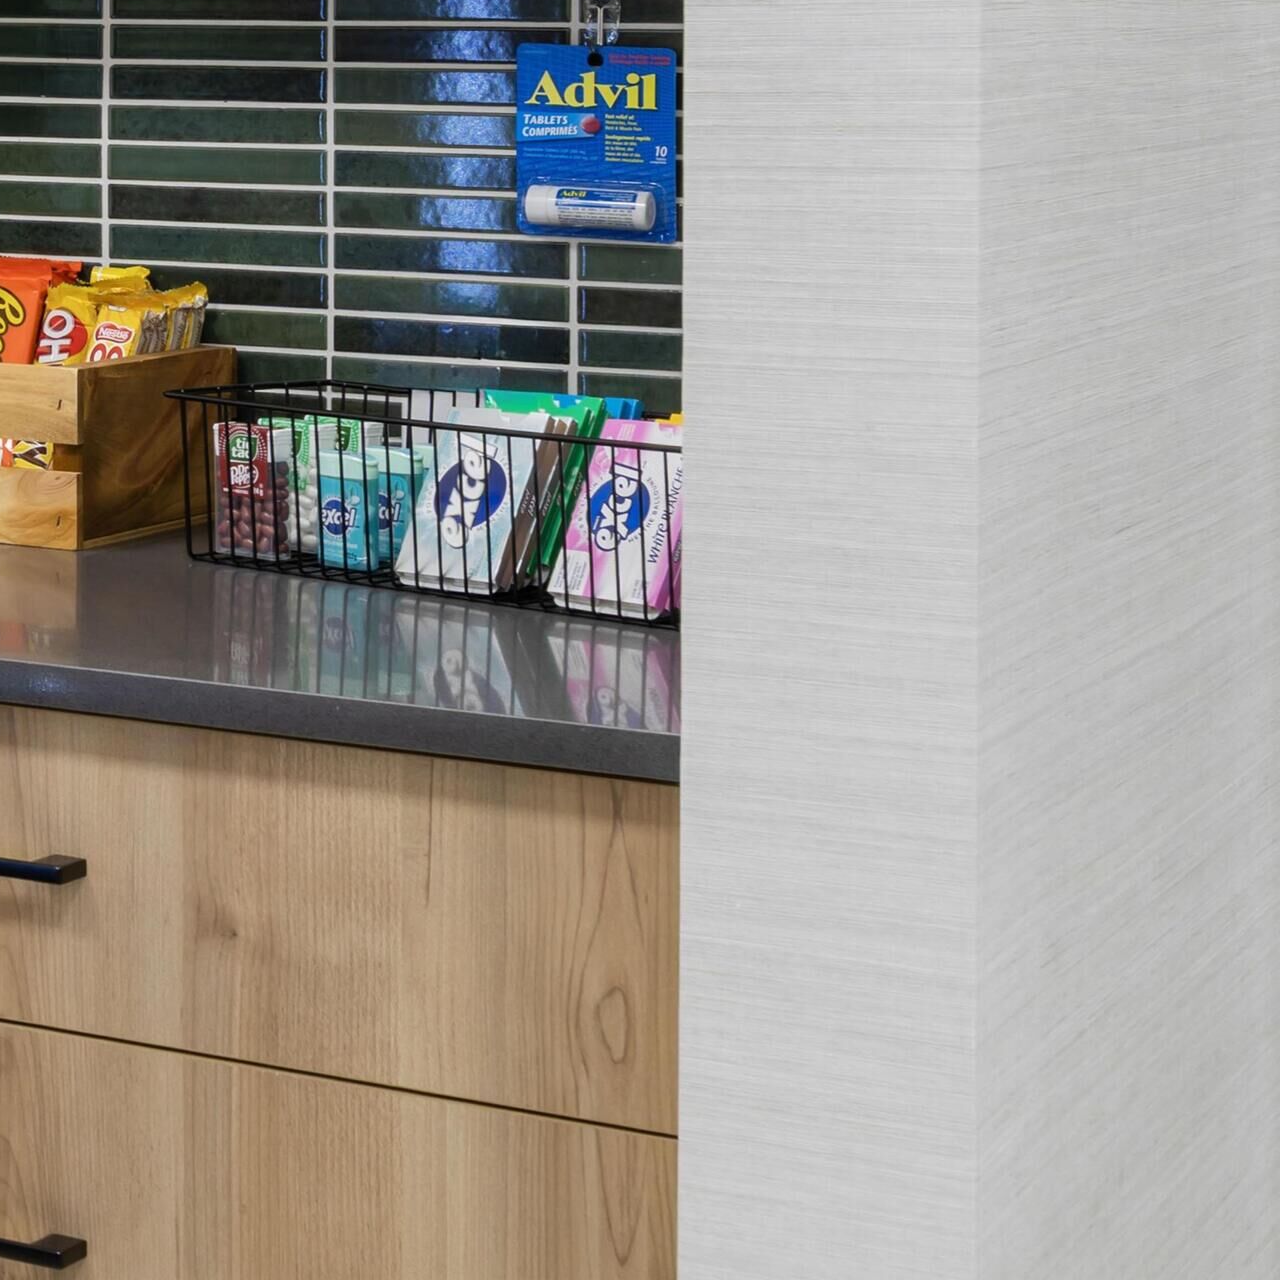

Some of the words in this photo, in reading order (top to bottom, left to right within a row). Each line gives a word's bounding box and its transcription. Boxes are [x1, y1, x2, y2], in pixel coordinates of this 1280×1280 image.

[524, 69, 658, 110] Advil
[522, 124, 578, 137] COMPRIMÉS
[523, 114, 568, 125] TABLETS
[655, 146, 668, 158] 10
[441, 432, 499, 550] excel
[595, 462, 643, 552] excel
